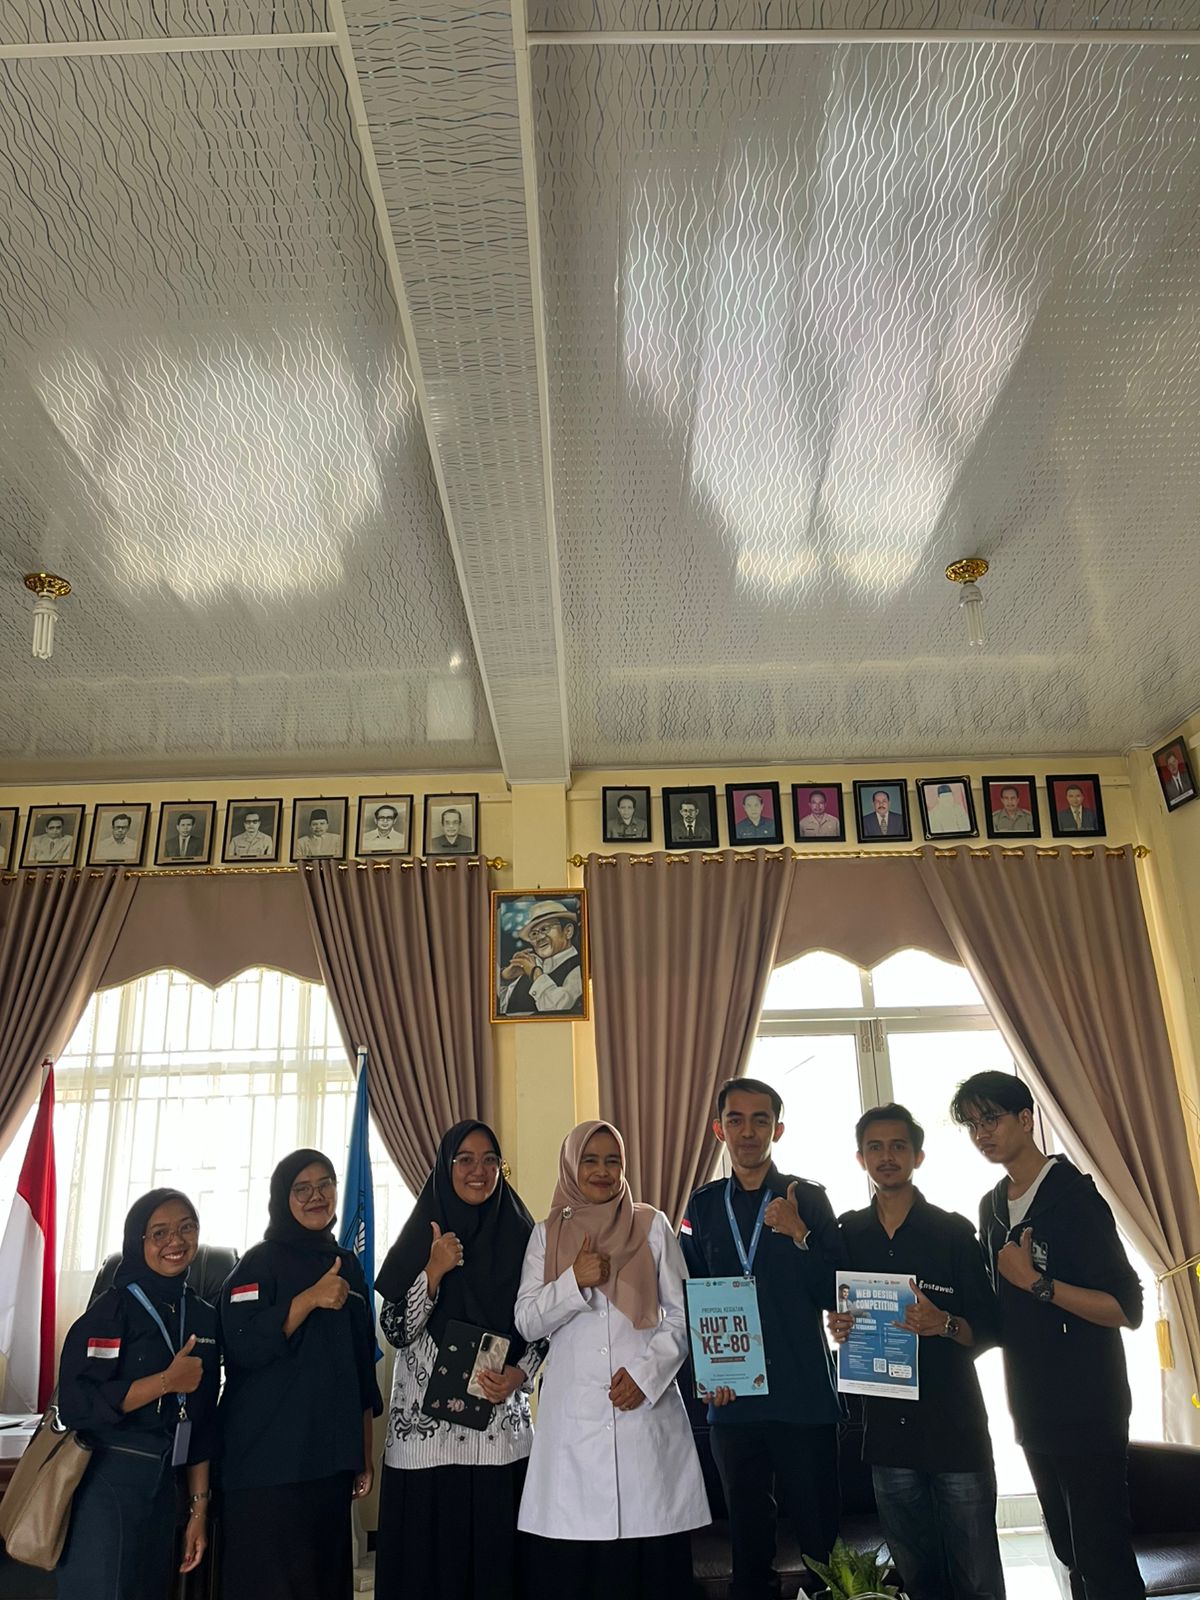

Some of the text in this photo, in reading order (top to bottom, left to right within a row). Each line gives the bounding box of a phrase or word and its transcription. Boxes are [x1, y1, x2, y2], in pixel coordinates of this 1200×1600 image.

[855, 1289, 898, 1301] WEB DESIGN
[855, 1299, 899, 1312] COMPETITION
[700, 1315, 748, 1334] HUT RI
[702, 1334, 750, 1355] KE-80
